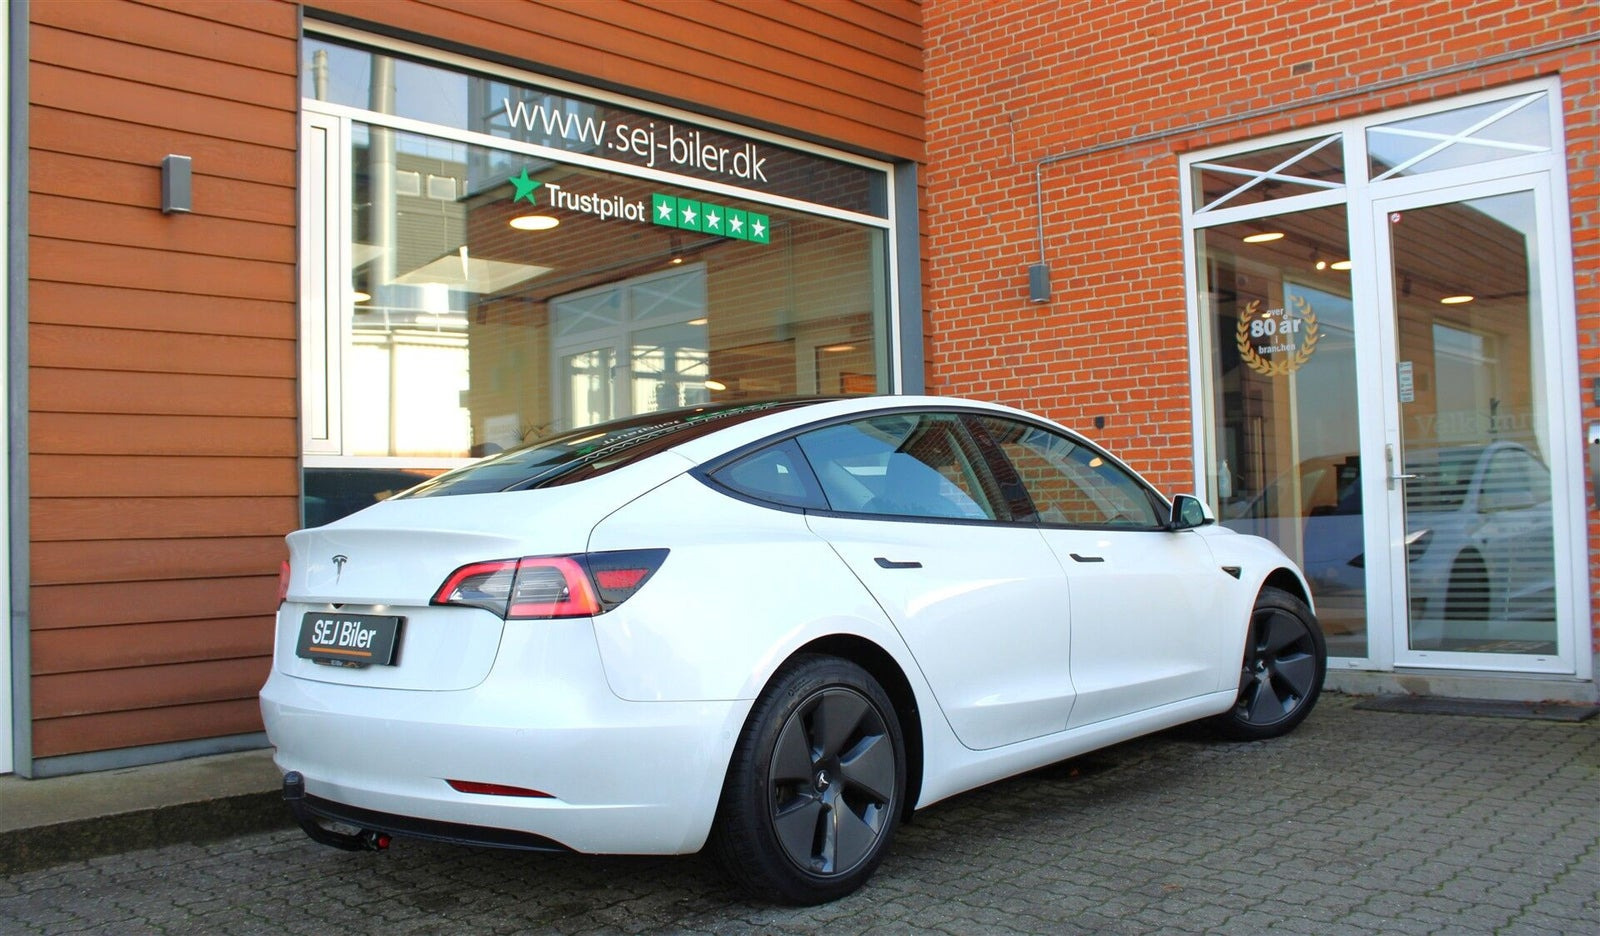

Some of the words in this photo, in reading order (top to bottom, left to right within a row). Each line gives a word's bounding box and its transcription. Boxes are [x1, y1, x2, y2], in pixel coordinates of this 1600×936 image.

[504, 97, 768, 183] www.sej-biler.dk
[544, 183, 646, 223] Trustpilot
[1251, 318, 1276, 338] 80
[1279, 314, 1302, 334] år
[312, 619, 340, 645] SEJ
[338, 621, 377, 649] Biler
